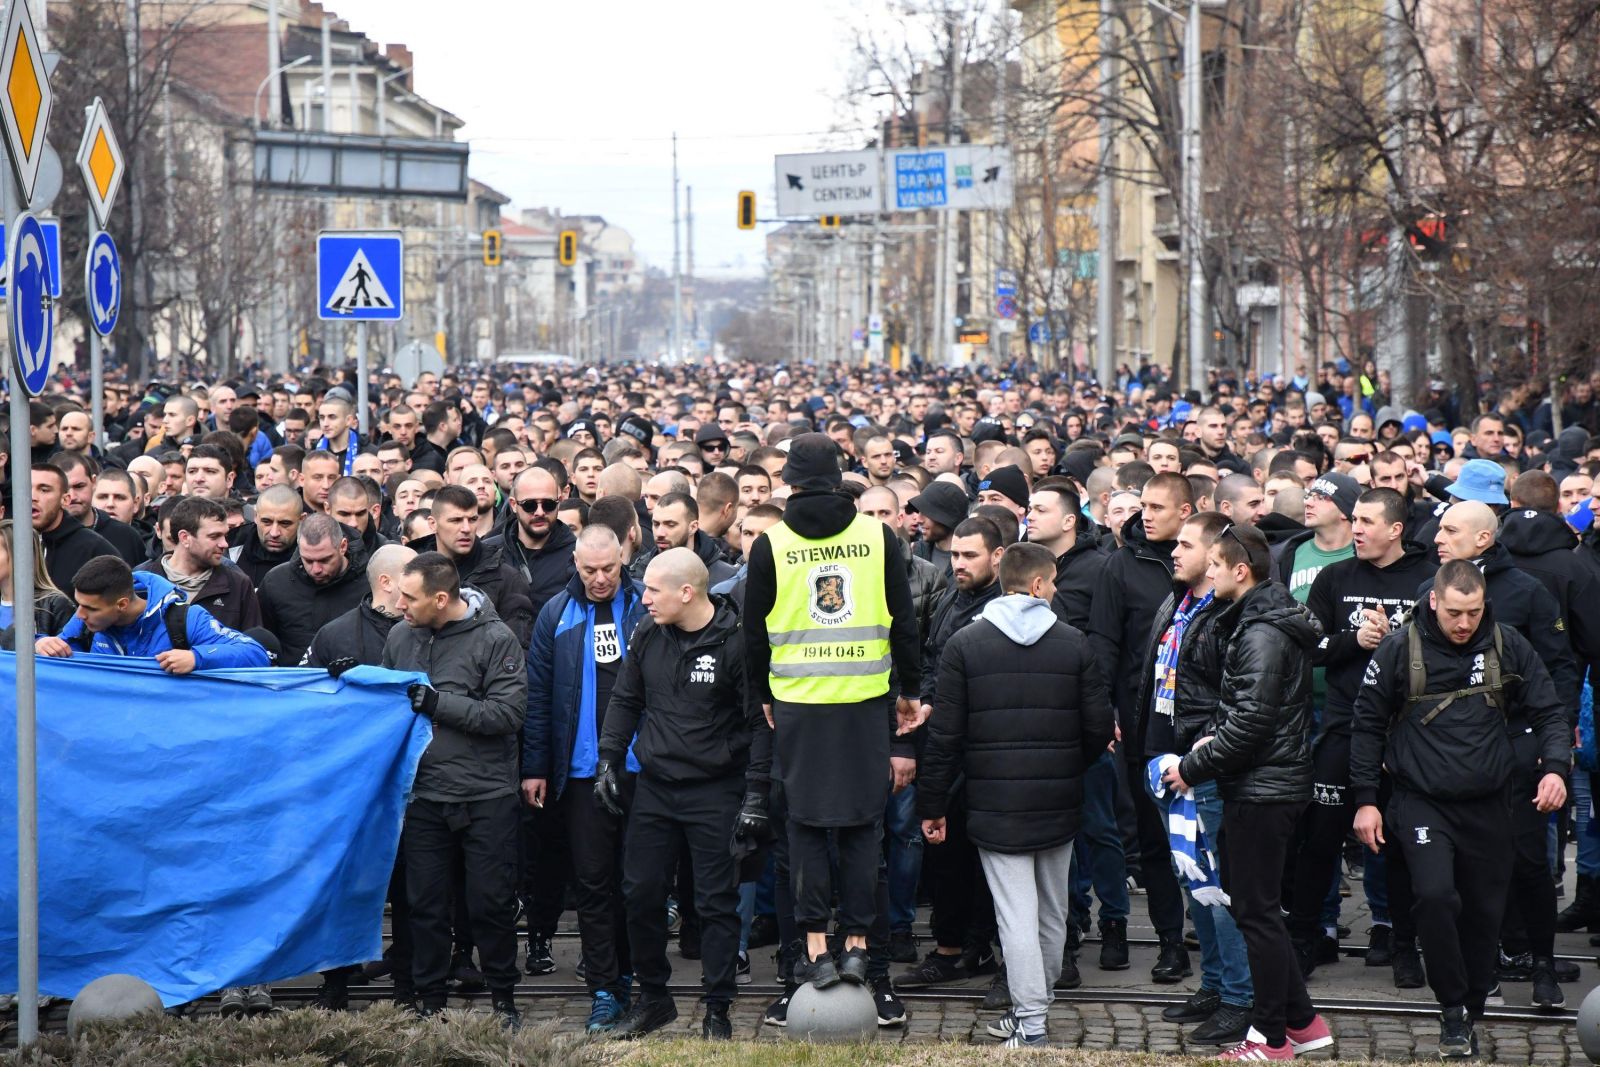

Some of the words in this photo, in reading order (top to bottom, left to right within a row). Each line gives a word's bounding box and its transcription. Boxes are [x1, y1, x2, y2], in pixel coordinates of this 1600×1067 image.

[812, 163, 866, 179] ЦЕНТЪР
[899, 173, 943, 188] ВАРНА
[814, 186, 871, 202] CENTRUM
[901, 190, 945, 206] VARNA
[787, 544, 870, 564] STEWARD
[820, 565, 838, 573] LSFC
[811, 610, 852, 625] SECURITY
[594, 630, 617, 642] SW
[596, 643, 617, 657] 99
[804, 646, 831, 657] 1914
[836, 646, 864, 657] 045
[690, 671, 715, 683] SW99
[1470, 671, 1485, 685] SW
